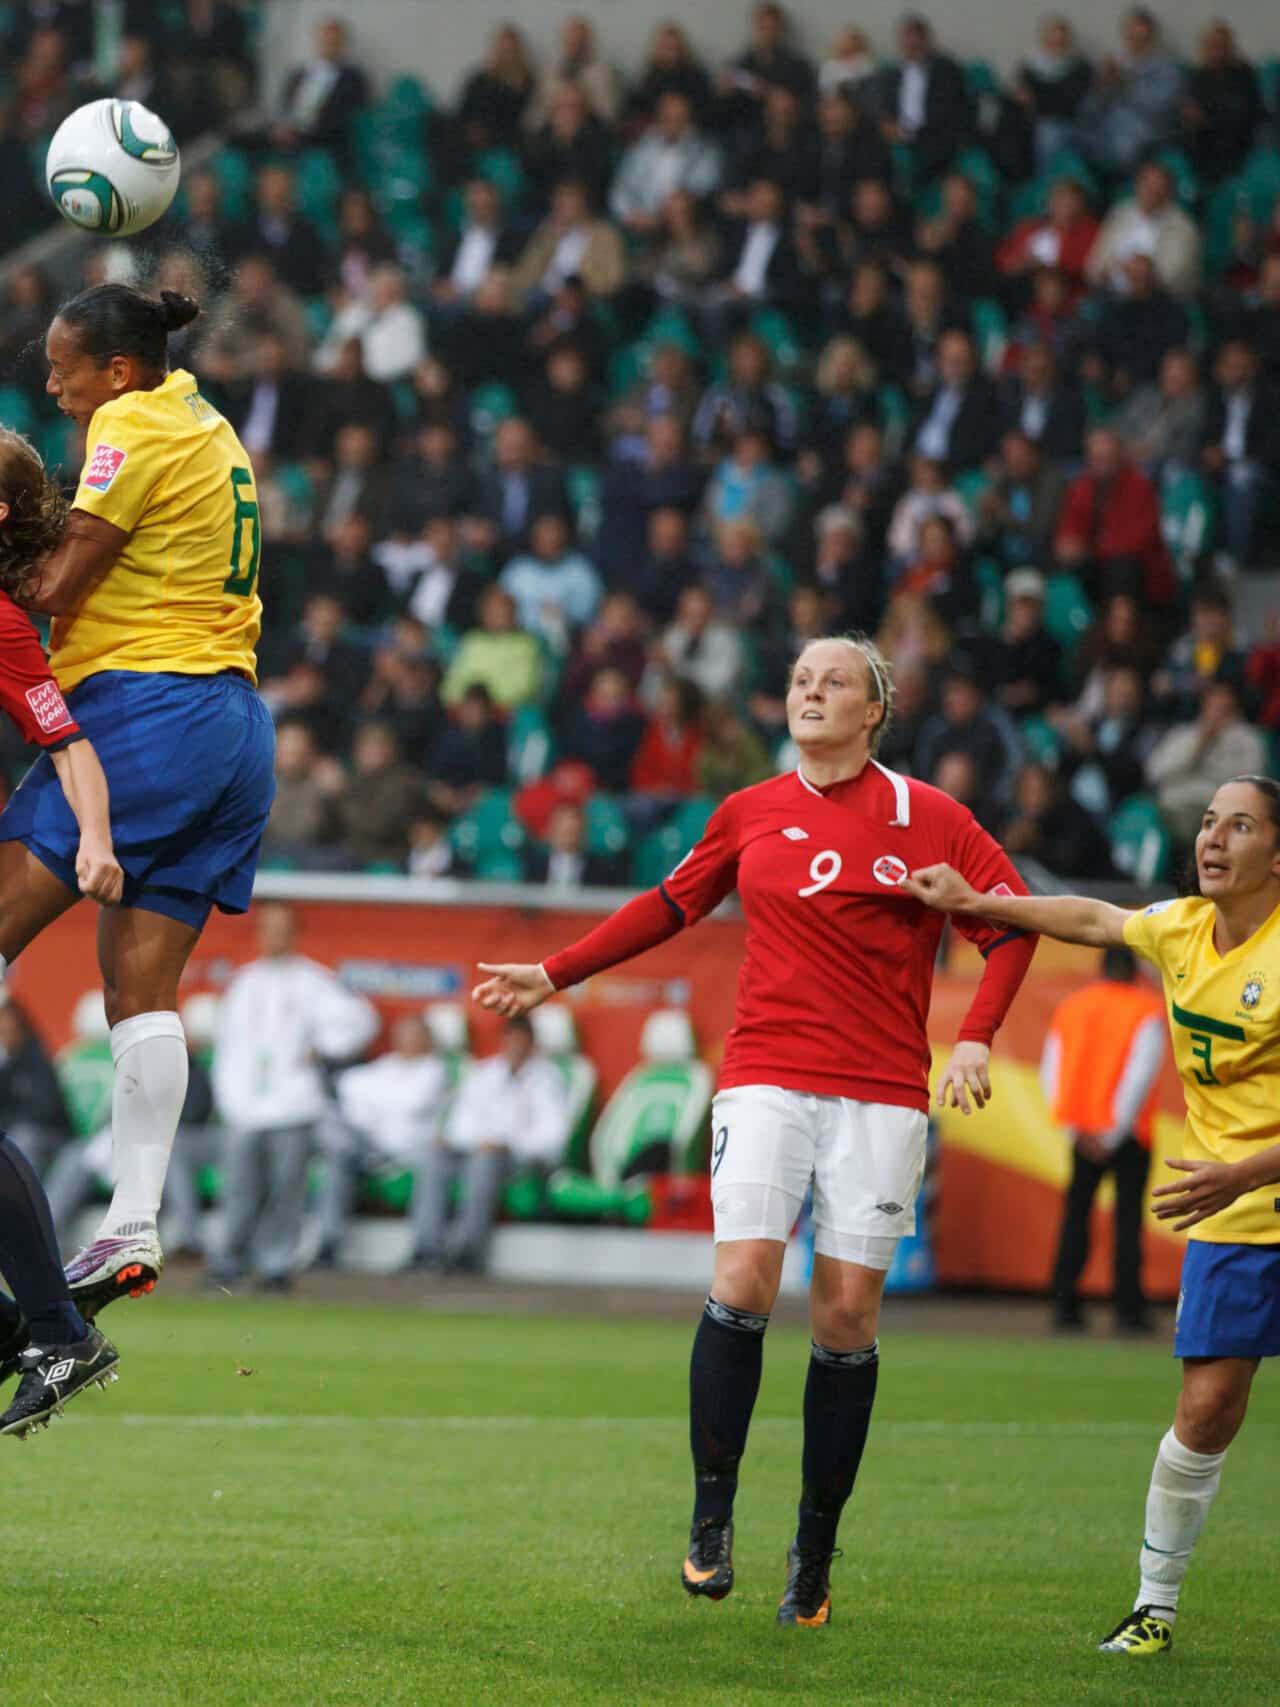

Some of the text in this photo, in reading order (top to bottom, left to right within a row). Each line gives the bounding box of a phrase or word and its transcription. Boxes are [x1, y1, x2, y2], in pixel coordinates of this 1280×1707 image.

[223, 466, 259, 597] 6
[31, 684, 53, 706] LIVE
[41, 703, 66, 727] GOAL
[798, 850, 842, 897] 9
[1190, 1031, 1222, 1087] 3
[713, 1126, 729, 1178] 9
